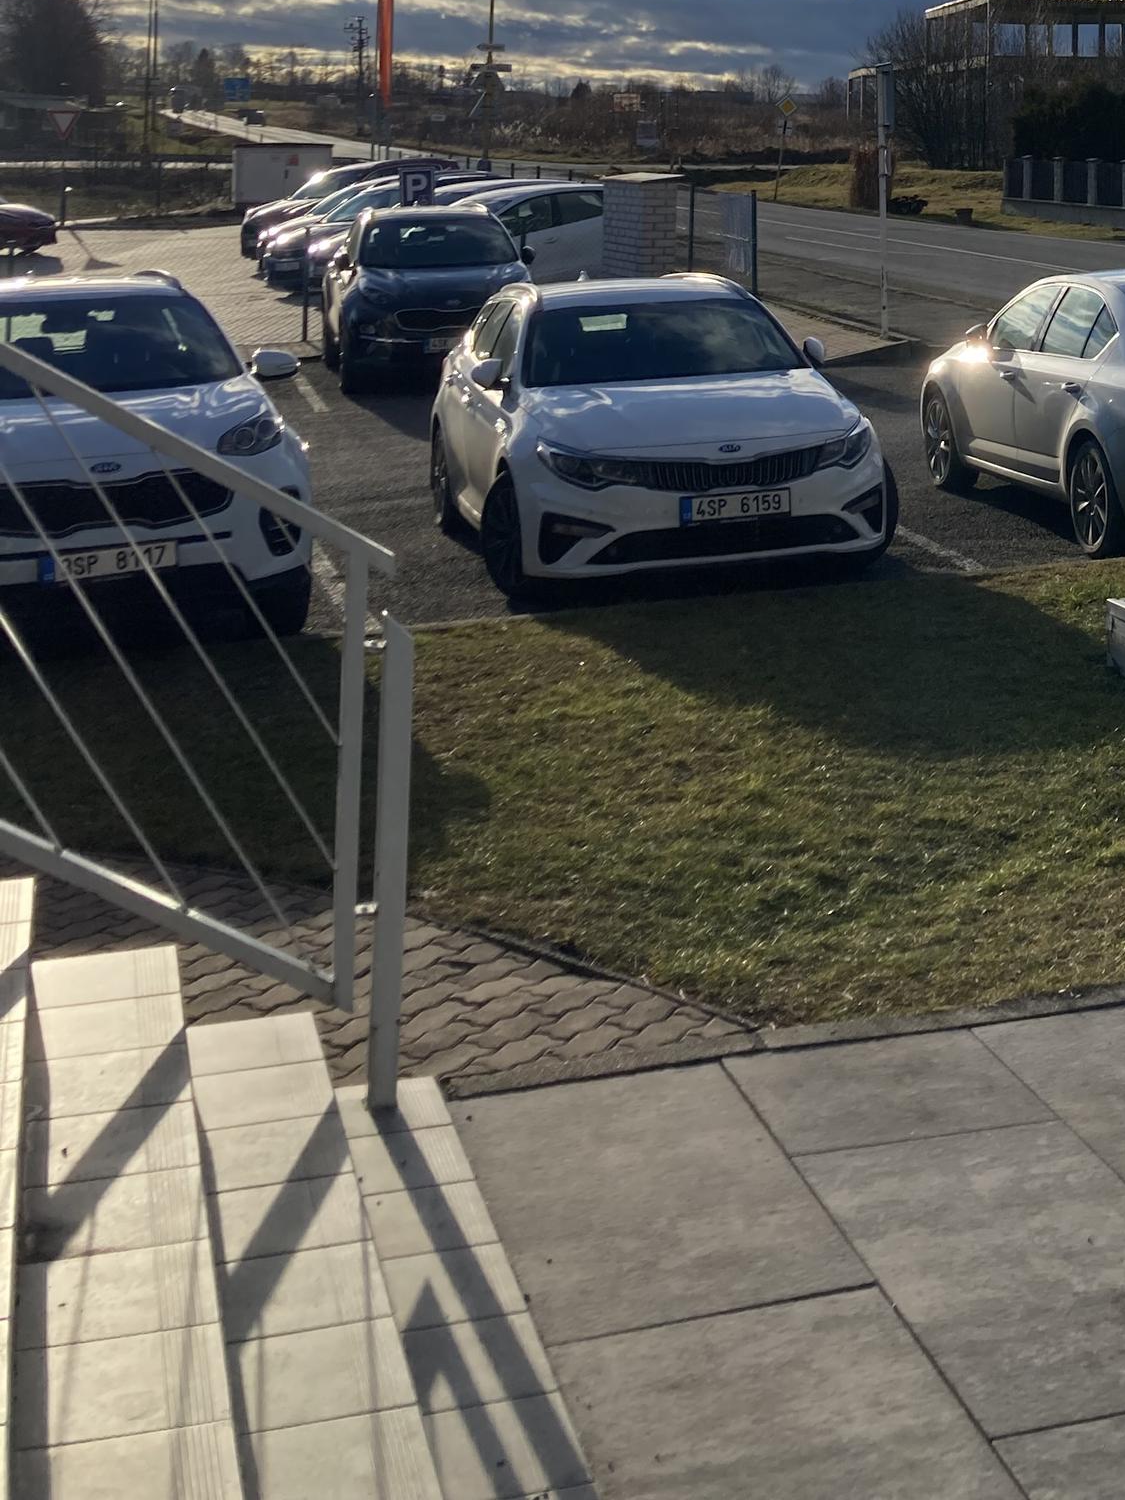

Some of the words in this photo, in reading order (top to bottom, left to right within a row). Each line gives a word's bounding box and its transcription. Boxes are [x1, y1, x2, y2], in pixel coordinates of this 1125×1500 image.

[406, 174, 428, 201] P
[696, 499, 728, 517] 4SP
[740, 493, 782, 513] 6159
